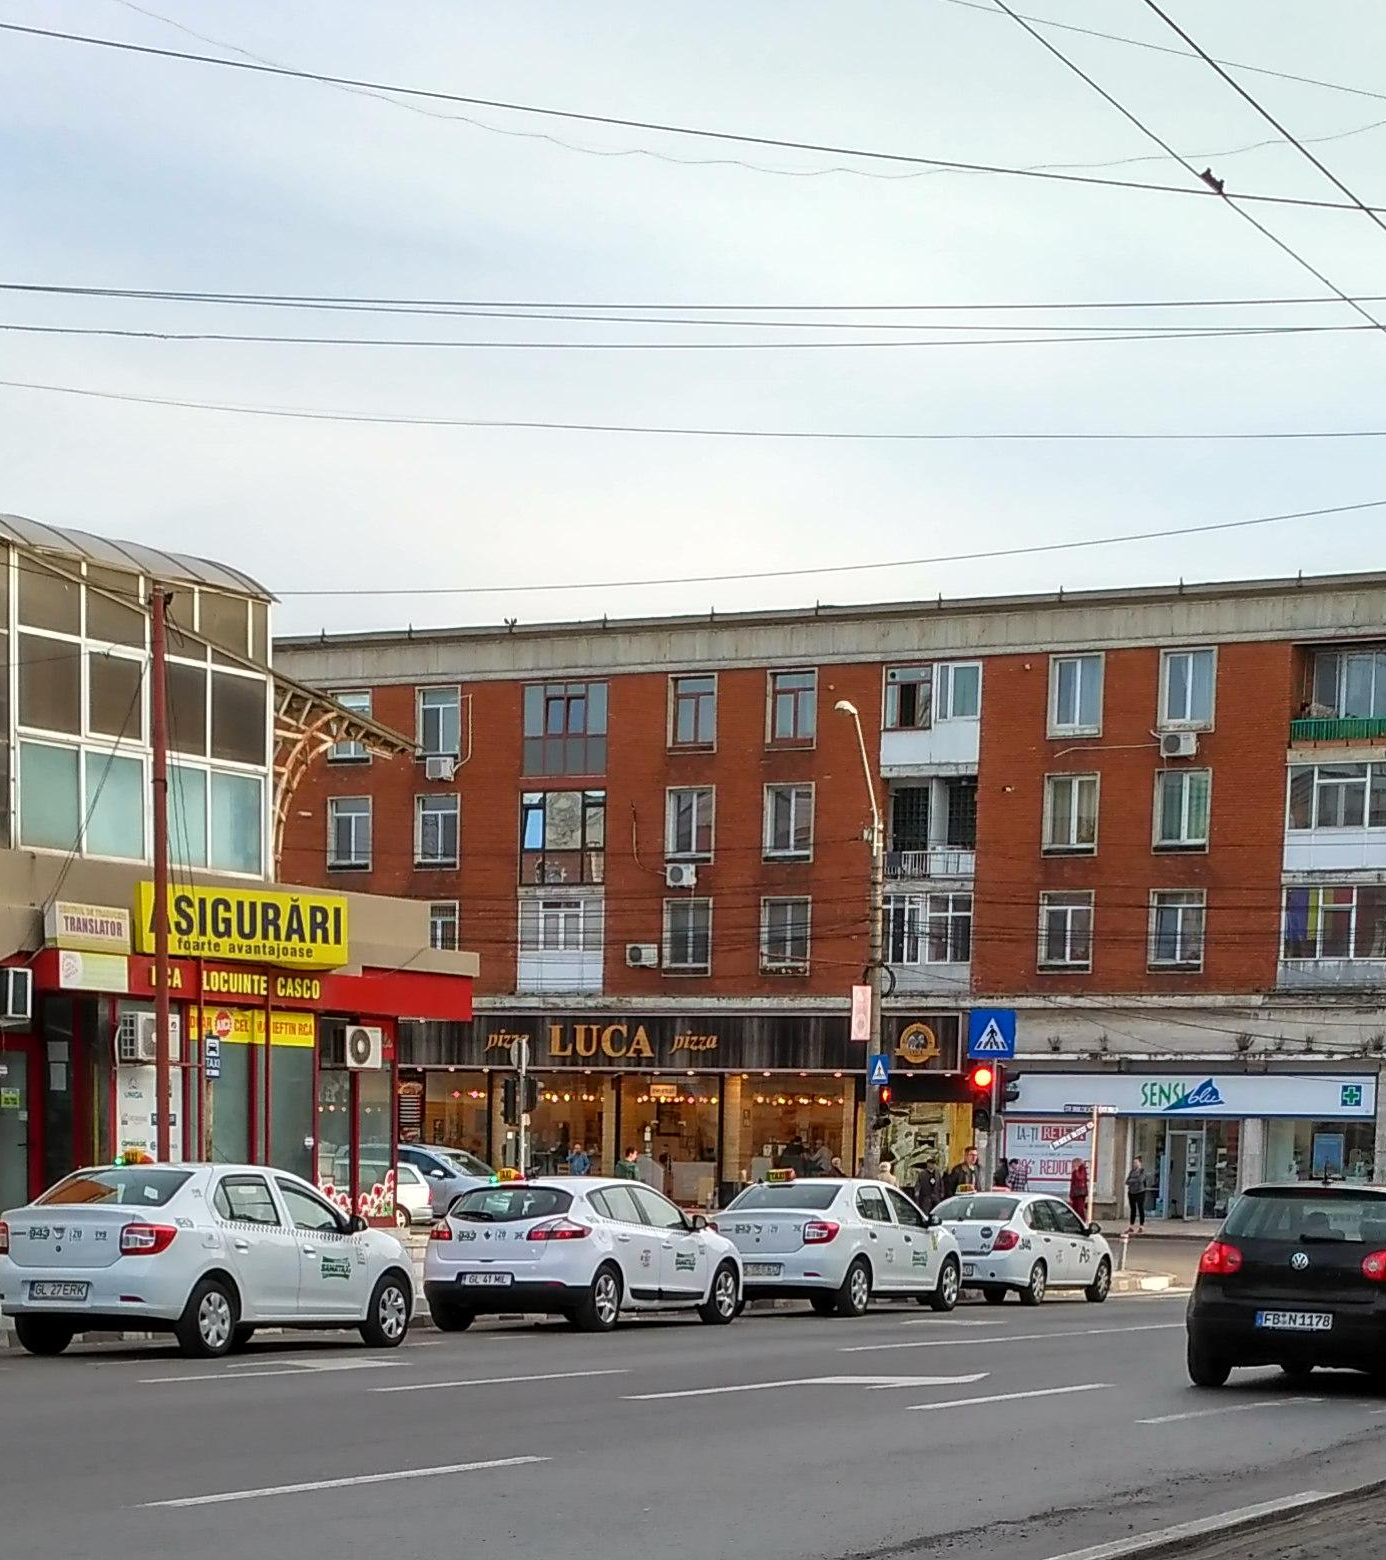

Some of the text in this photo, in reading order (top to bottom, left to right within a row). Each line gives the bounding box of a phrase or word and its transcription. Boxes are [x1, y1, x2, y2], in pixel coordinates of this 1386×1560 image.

[63, 915, 123, 937] TRANSLATOR
[177, 937, 314, 960] foarte avantajoase
[202, 970, 268, 996] LOCUINTE
[277, 977, 321, 1000] CASCO
[234, 1019, 249, 1032] CEL
[548, 1025, 655, 1058] LUCA
[667, 1030, 717, 1054] pizza
[206, 1058, 220, 1068] TAXI
[1141, 1082, 1220, 1106] SENSI blu
[35, 1284, 47, 1295] GL
